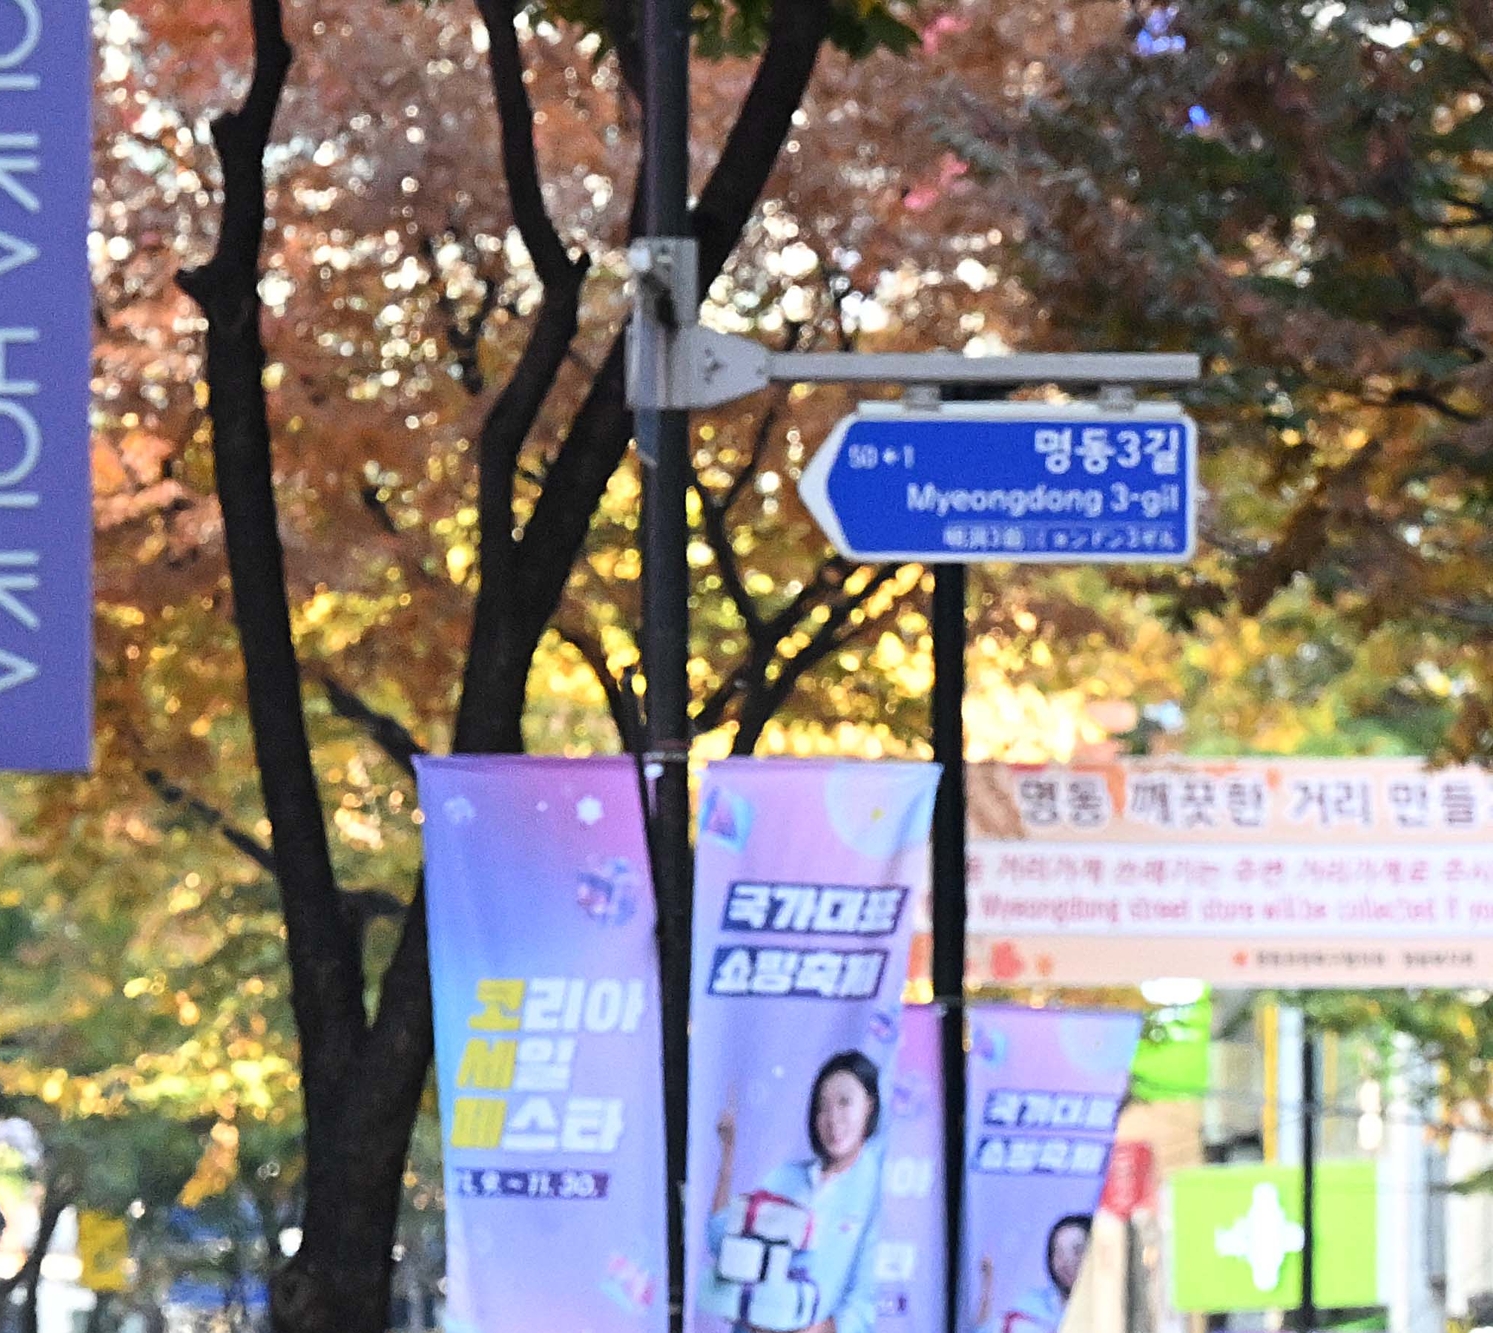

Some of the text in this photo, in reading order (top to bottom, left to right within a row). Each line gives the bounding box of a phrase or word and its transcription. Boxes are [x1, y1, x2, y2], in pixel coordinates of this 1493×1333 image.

[1034, 428, 1180, 474] 명동3길
[907, 482, 1180, 517] Myeongdong 3-gil
[1019, 776, 1493, 827] 명동 깨끗한 거리 만들
[728, 884, 902, 932] 국가대표
[712, 948, 884, 997] 쇼핑축제
[468, 979, 644, 1032] 코리아
[456, 1038, 576, 1090] 세일
[450, 1098, 623, 1152] 페스타
